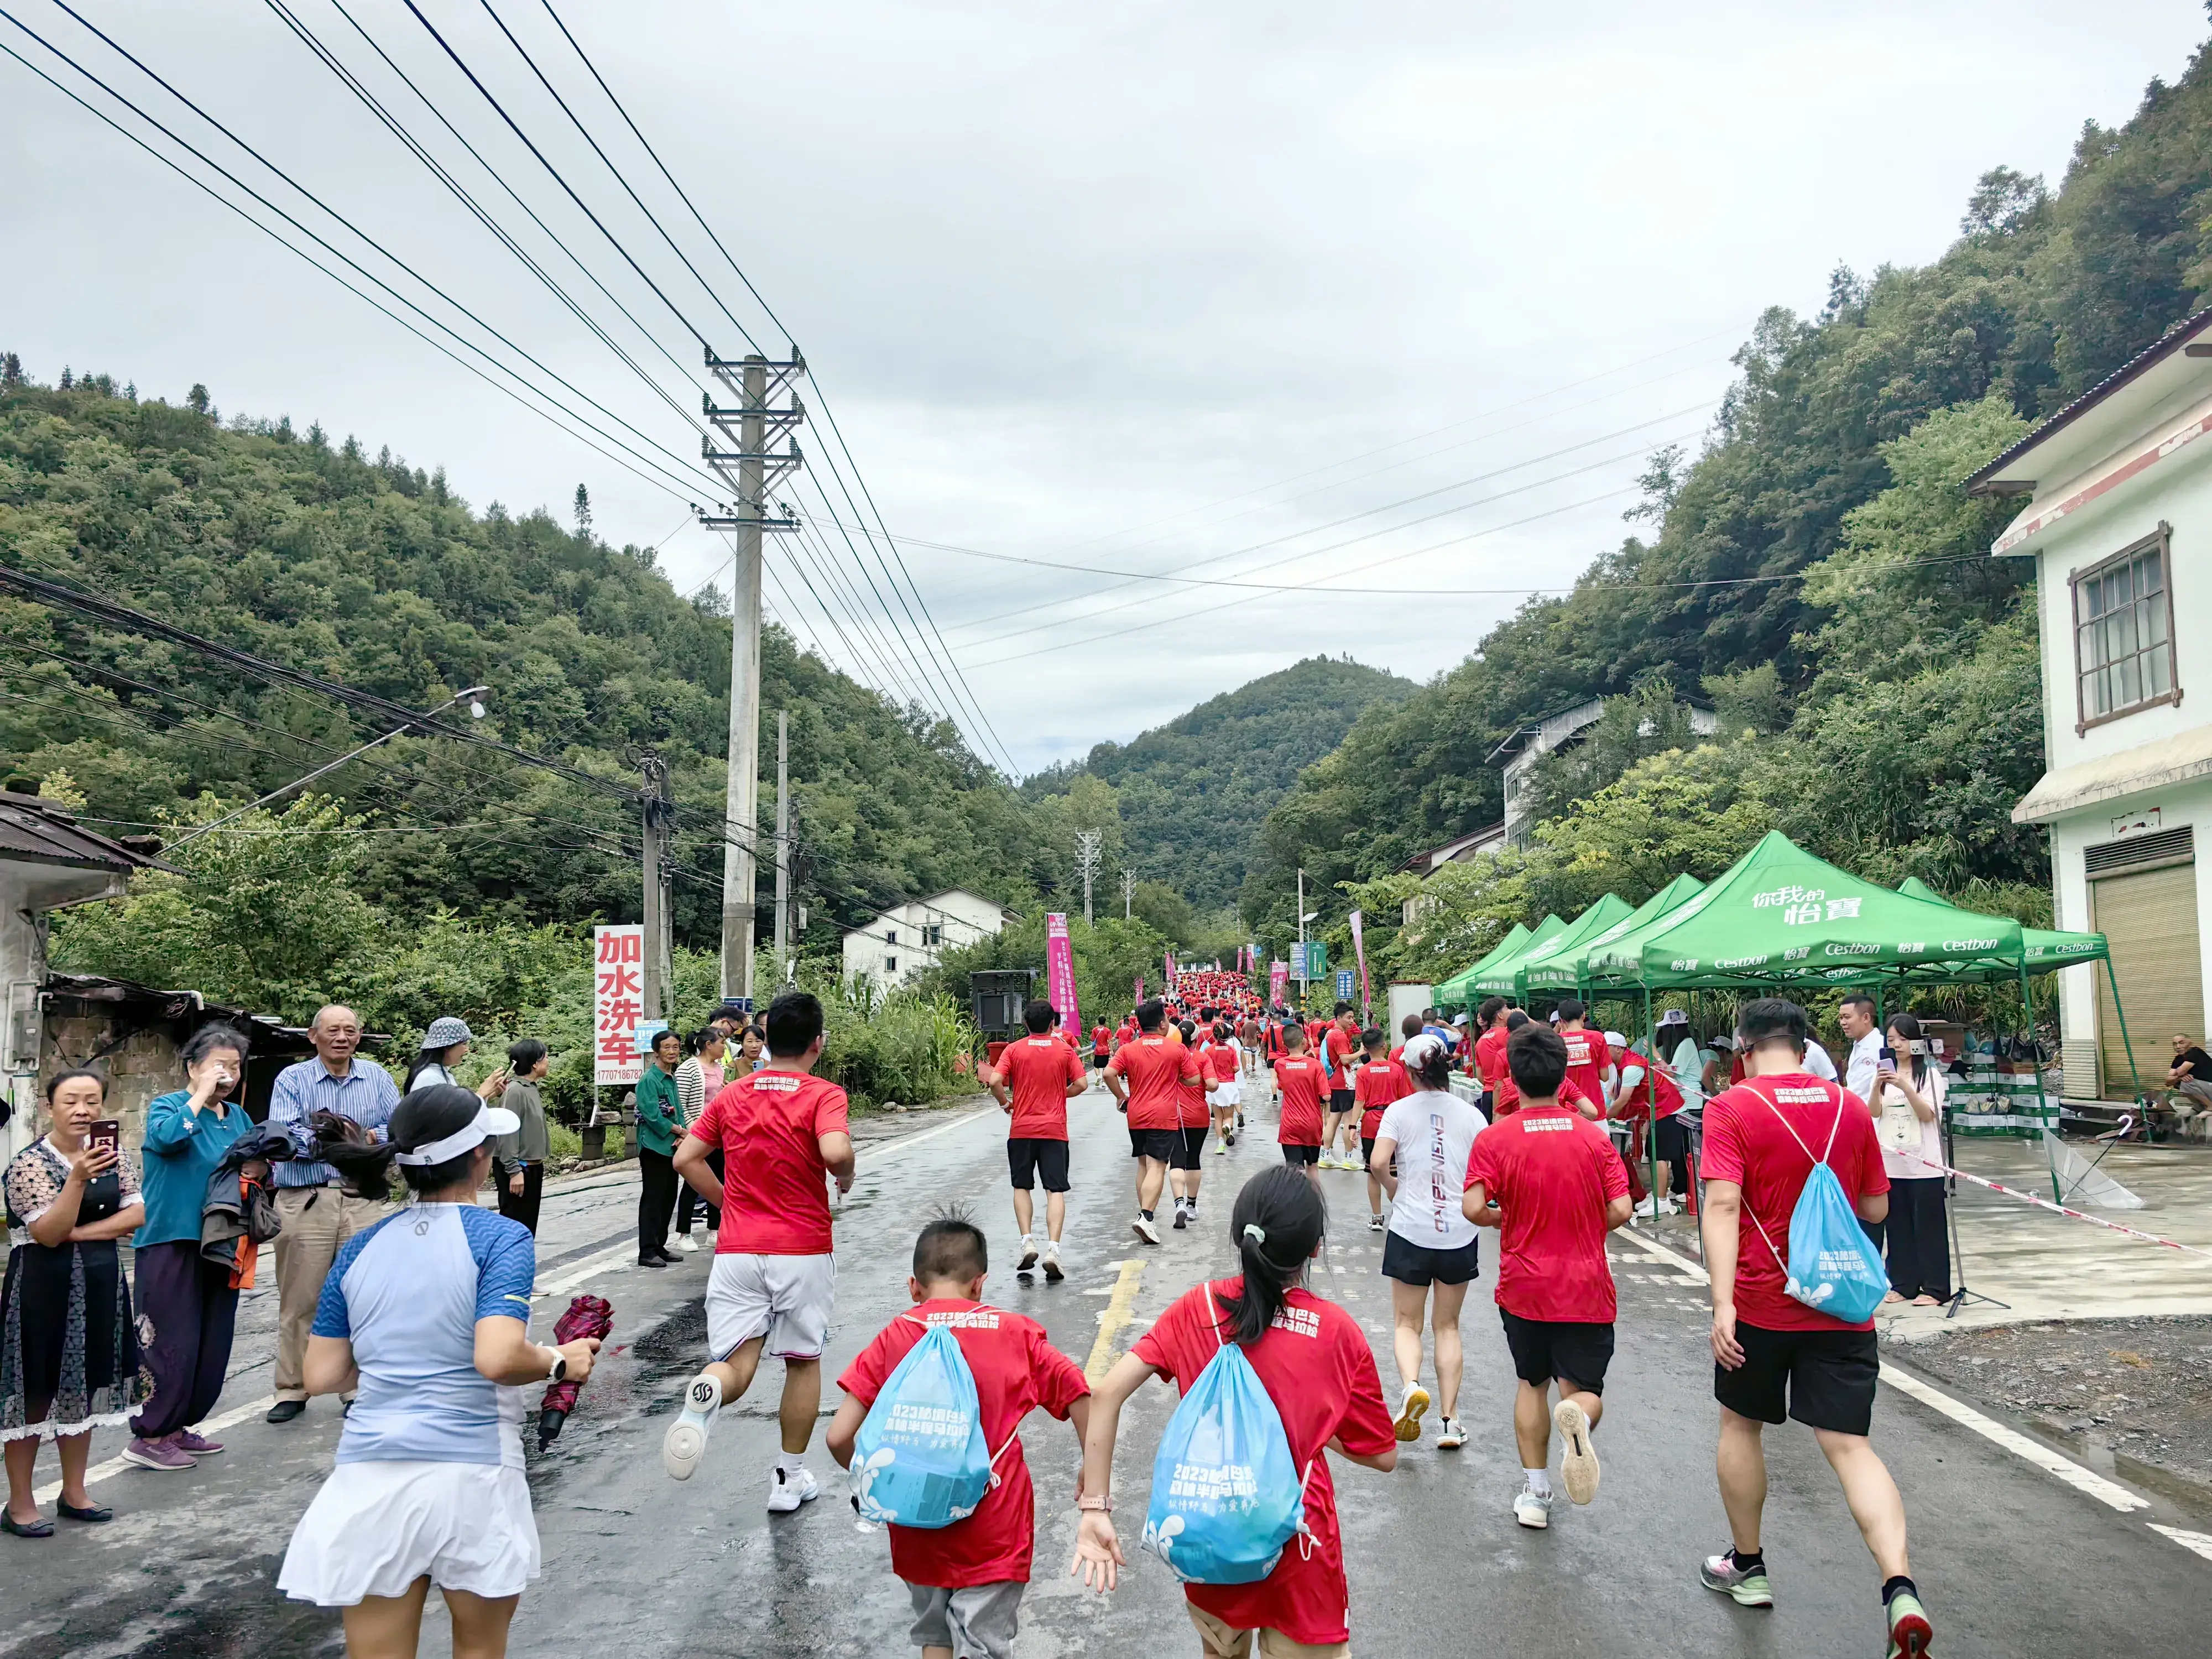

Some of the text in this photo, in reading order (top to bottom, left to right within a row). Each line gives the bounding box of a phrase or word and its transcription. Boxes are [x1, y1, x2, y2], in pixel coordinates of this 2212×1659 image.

[1752, 885, 1825, 908] 你我的
[597, 931, 643, 1065] 加水洗车
[597, 1069, 643, 1081] 17707186782
